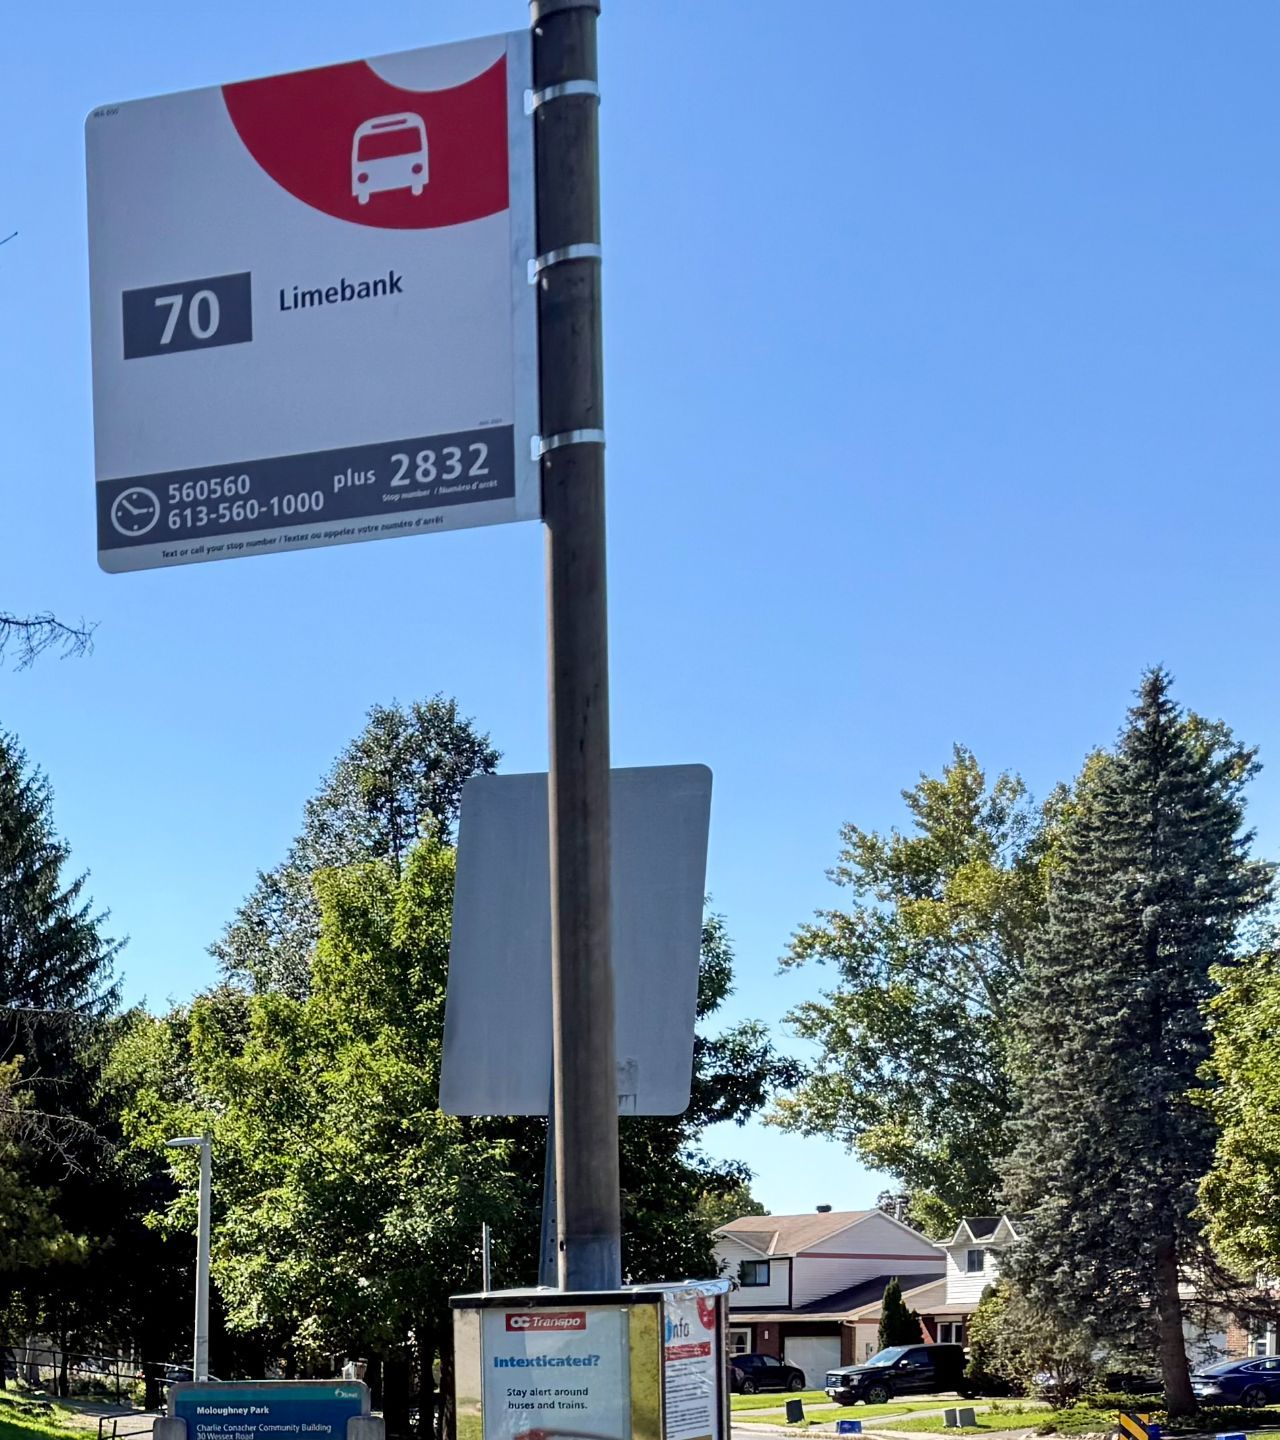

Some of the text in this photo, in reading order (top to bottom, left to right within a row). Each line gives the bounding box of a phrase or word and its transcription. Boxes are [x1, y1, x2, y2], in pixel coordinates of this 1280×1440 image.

[279, 270, 403, 311] Limebank
[154, 289, 220, 345] 70
[389, 442, 490, 487] 2832
[333, 467, 377, 493] plus
[168, 474, 251, 504] 560560
[382, 493, 400, 502] Stop
[167, 490, 325, 530] 613-560-1000
[162, 550, 178, 559] Text
[179, 549, 189, 557] or
[190, 546, 205, 555] call
[207, 544, 225, 555] your
[226, 542, 244, 551] stop
[245, 537, 277, 549] number
[310, 531, 322, 539] ou
[323, 526, 355, 539] appelez
[357, 524, 379, 534] votre
[510, 1316, 581, 1328] OC Transpo
[493, 1354, 601, 1368] Intexticated?
[506, 1387, 589, 1398] Stay alert around
[196, 1406, 269, 1416] Moloughney Park
[508, 1400, 588, 1409] buses and trains.
[196, 1424, 332, 1433] Charlie Conacher Community Building
[196, 1433, 254, 1440] 30 Wessex Road
